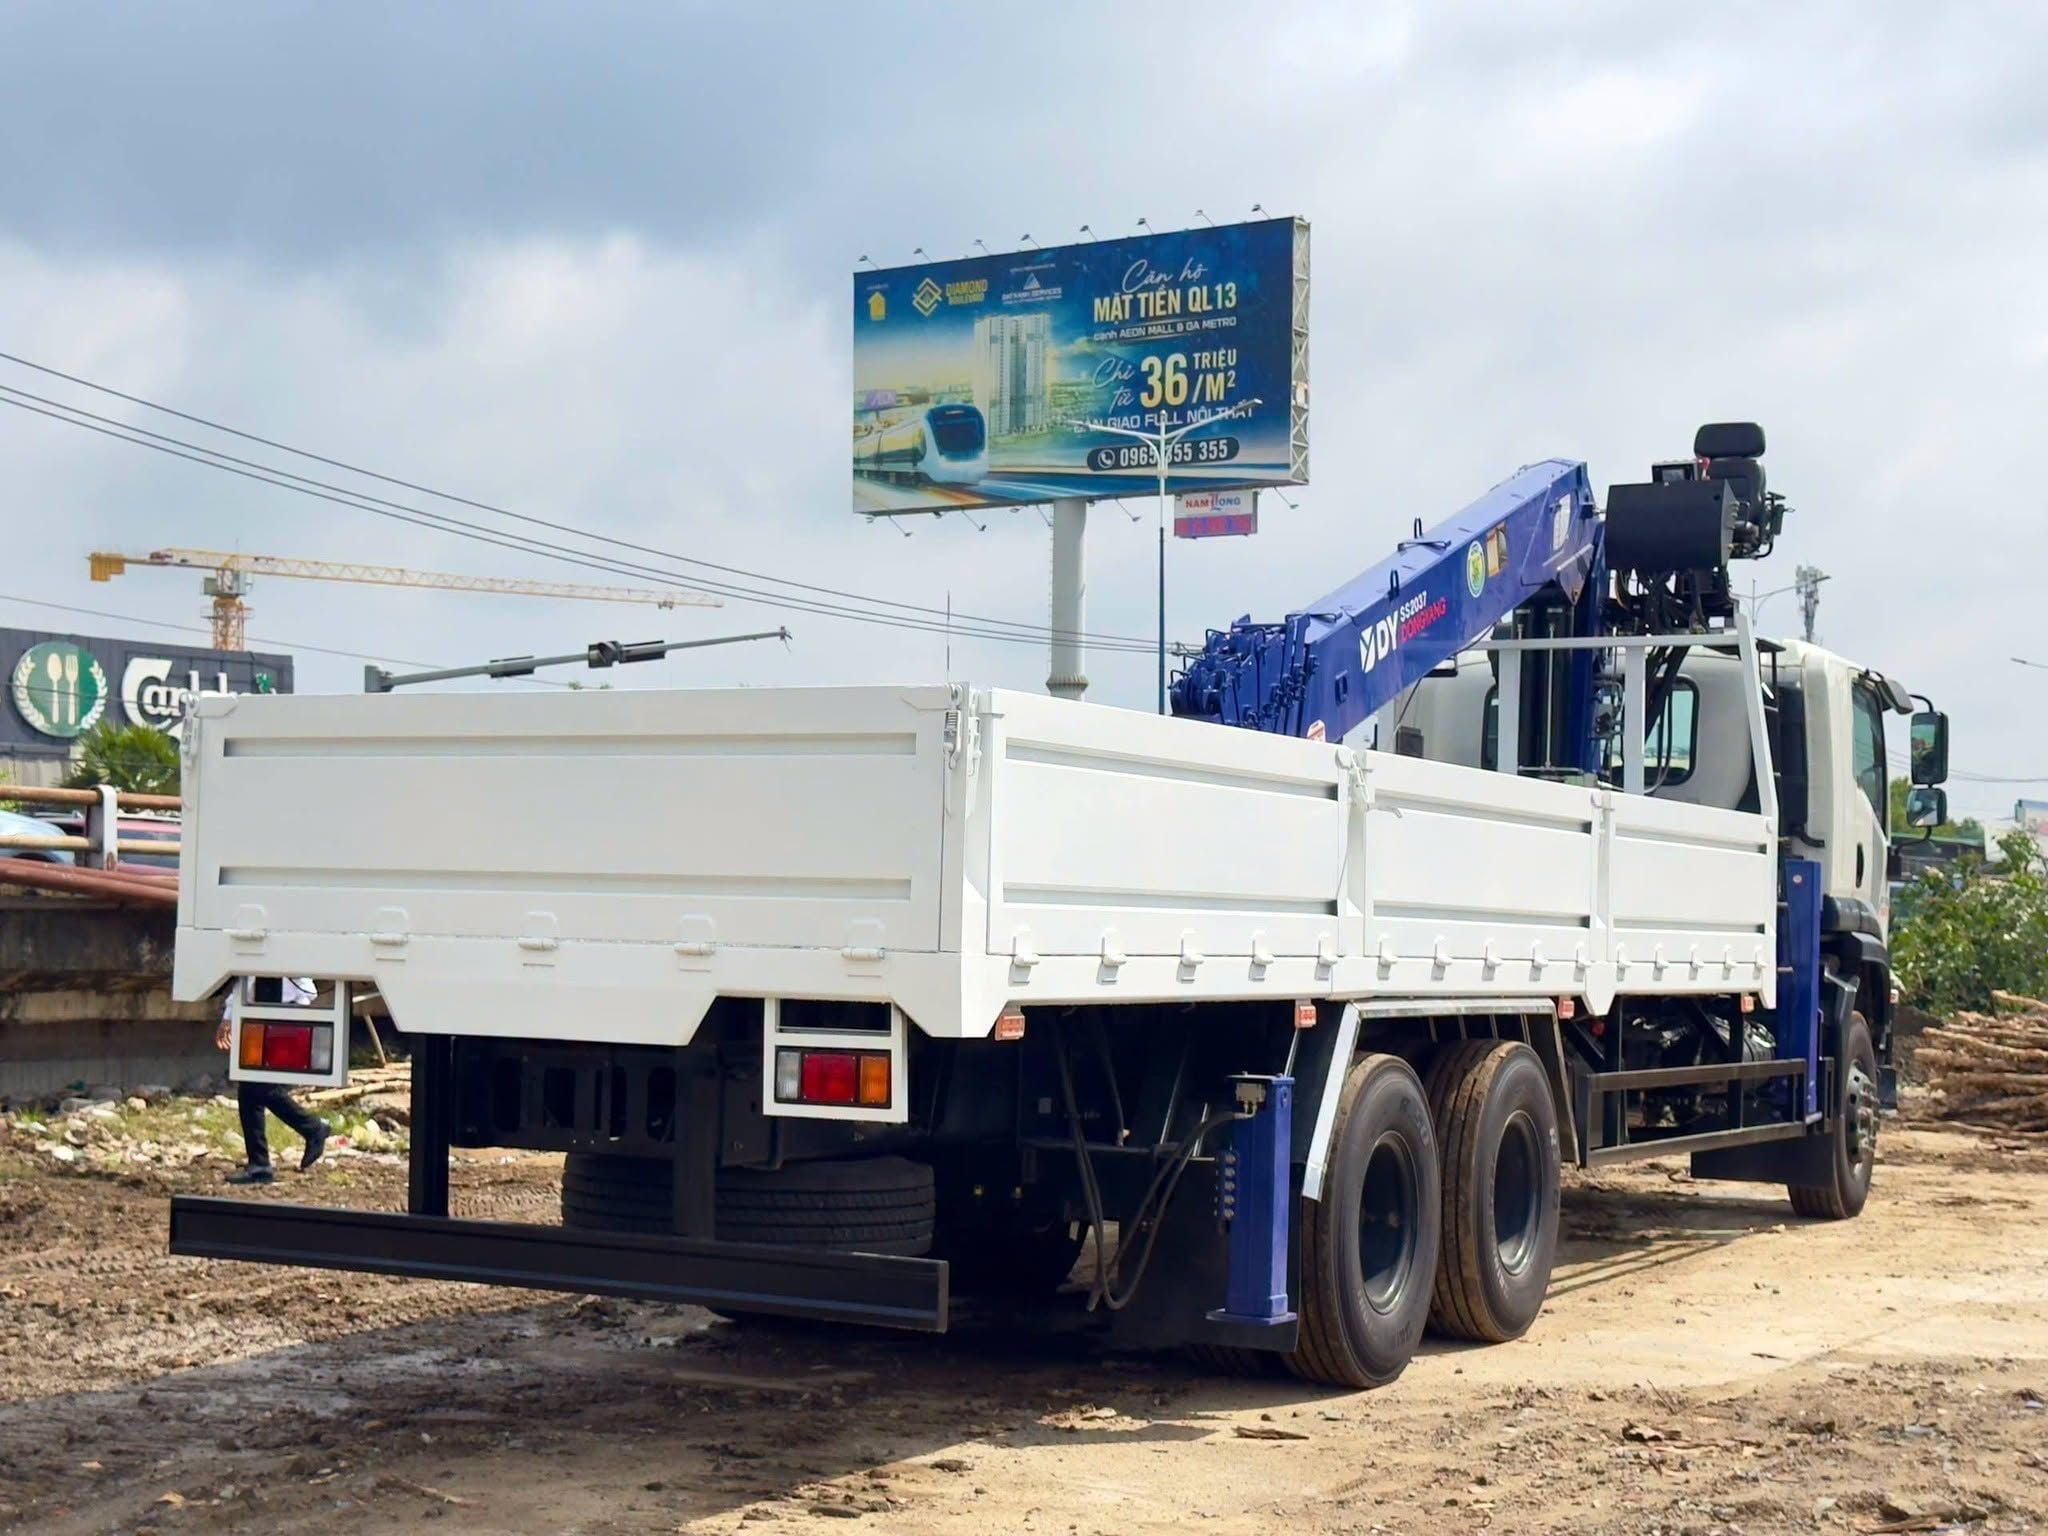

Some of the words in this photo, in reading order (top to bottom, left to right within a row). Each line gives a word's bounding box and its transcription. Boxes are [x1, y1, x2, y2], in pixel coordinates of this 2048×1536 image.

[946, 279, 988, 297] DIAMOND
[1094, 291, 1133, 325] MẶT
[1137, 285, 1181, 318] TIỀN
[1119, 327, 1146, 338] AEON
[1148, 325, 1175, 335] MALL
[1202, 317, 1237, 329] METRO
[1140, 353, 1188, 408] 36
[1193, 348, 1237, 370] TRIỆU
[1107, 415, 1140, 430] GIAO
[1145, 411, 1183, 427] FULL
[1199, 439, 1227, 461] 355
[1185, 499, 1209, 509] NAM
[1400, 589, 1427, 622] SS2037
